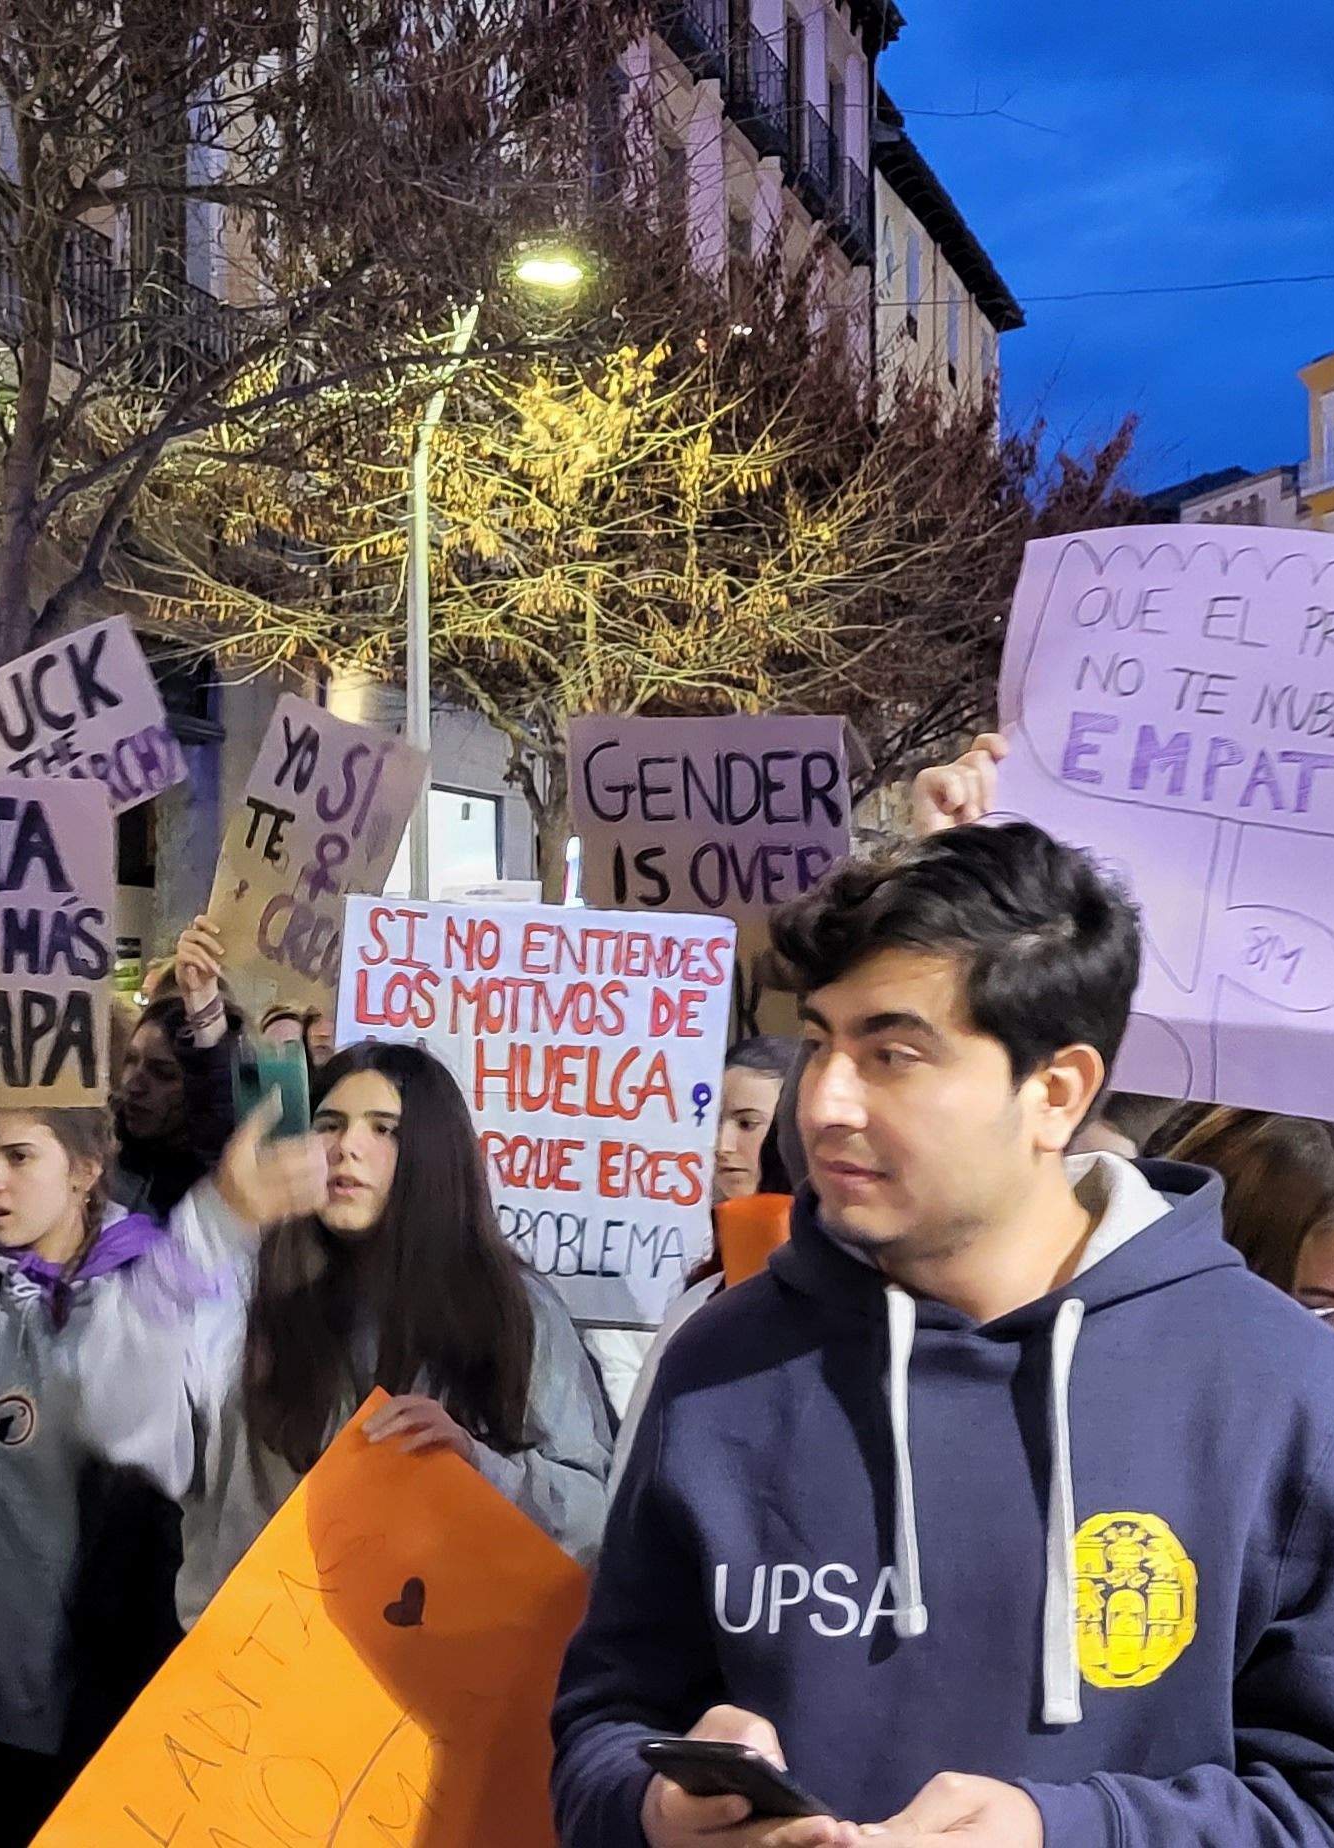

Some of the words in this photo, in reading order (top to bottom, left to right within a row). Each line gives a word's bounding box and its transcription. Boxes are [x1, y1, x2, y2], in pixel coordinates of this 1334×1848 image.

[1201, 595, 1267, 650] EL
[1075, 654, 1145, 697] NO
[1166, 667, 1238, 715] TE
[8, 730, 83, 777] THE
[274, 716, 320, 795] YO
[583, 740, 843, 827] GENDER
[246, 796, 296, 861] TE
[612, 842, 671, 906] IS
[689, 841, 834, 908] OVER
[2, 897, 110, 979] MÁS
[358, 907, 430, 970] SI
[444, 916, 502, 973] NO
[521, 923, 731, 986] ENTIENDES
[355, 969, 440, 1028] LOS
[449, 975, 630, 1036] MOTIVOS
[649, 986, 708, 1037] DE
[474, 1039, 678, 1122] HUELGA
[480, 1130, 585, 1192] RQUE
[597, 1140, 704, 1206] ERES
[497, 1204, 684, 1278] PROBLEMA
[714, 1563, 900, 1639] UPSA
